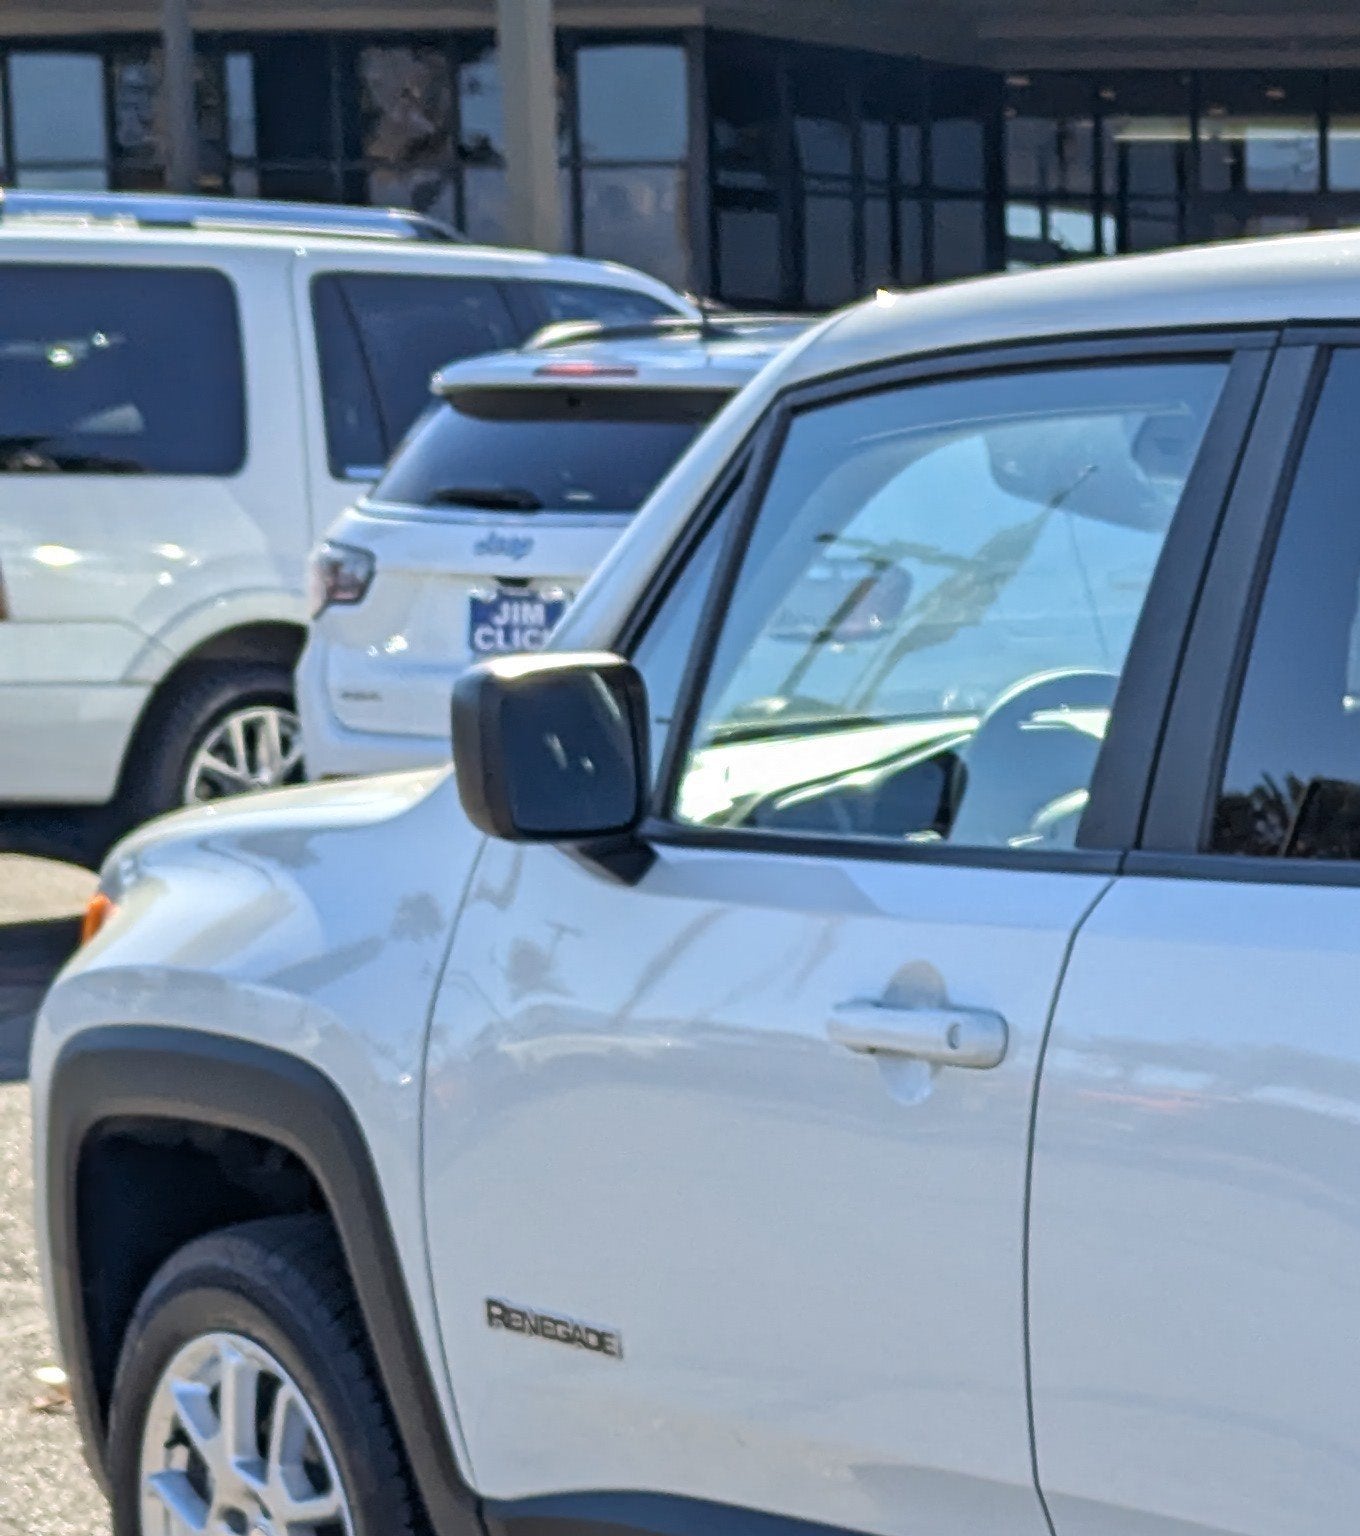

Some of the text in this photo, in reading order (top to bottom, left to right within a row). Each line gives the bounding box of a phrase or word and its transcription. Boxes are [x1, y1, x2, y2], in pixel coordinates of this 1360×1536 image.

[492, 602, 545, 626] JIM
[474, 624, 550, 651] CLIC
[486, 1298, 624, 1360] RENEGADE
